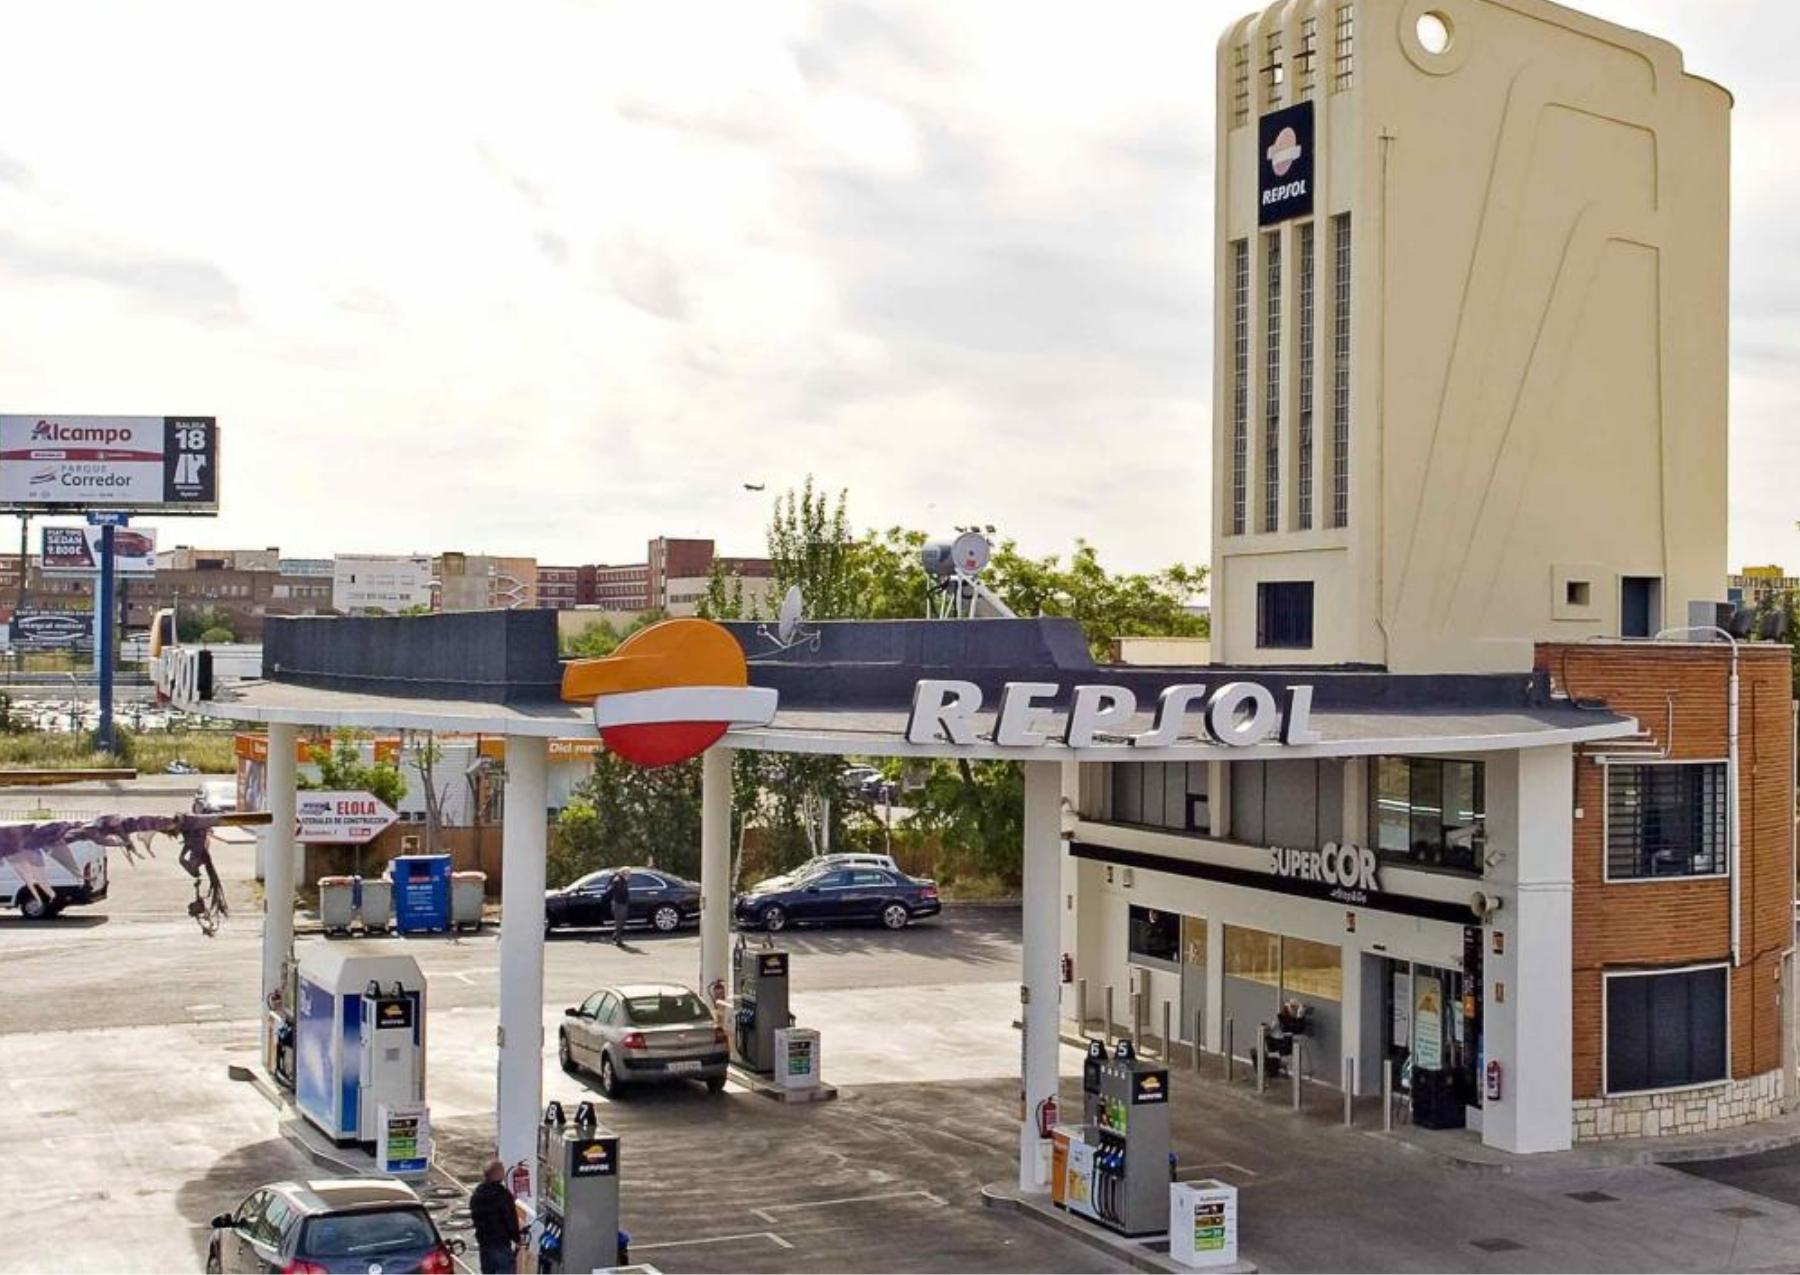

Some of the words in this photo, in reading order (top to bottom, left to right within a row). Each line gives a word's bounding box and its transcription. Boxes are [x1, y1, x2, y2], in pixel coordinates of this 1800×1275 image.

[1262, 180, 1307, 205] REPSOL
[32, 420, 132, 444] Alcampo
[175, 429, 205, 450] 18
[60, 472, 132, 487] Corredor
[904, 679, 1322, 748] REPSOL
[337, 801, 376, 815] ELOLA
[1269, 842, 1379, 891] SUPERCOR
[1091, 1042, 1100, 1057] 6
[1118, 1042, 1128, 1057] 5
[580, 1104, 589, 1120] 7
